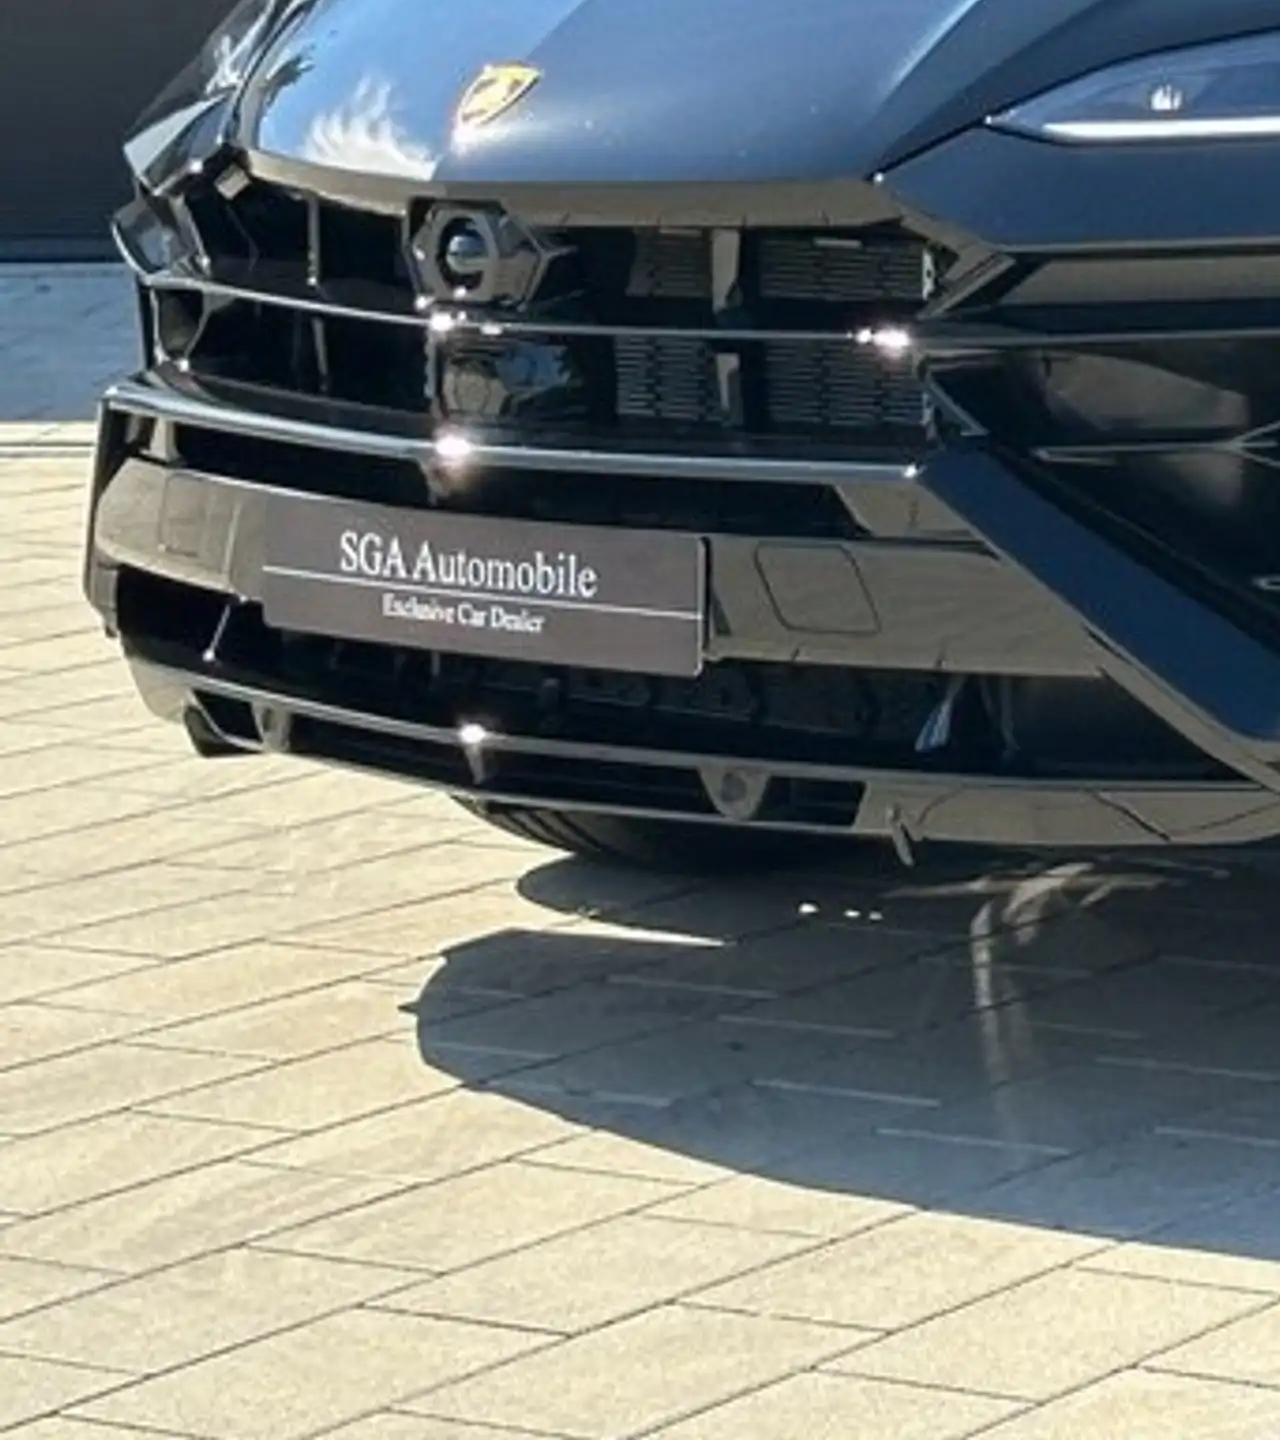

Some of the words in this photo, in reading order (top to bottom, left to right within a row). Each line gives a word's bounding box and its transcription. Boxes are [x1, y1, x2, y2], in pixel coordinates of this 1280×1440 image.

[340, 530, 406, 578] SGA
[412, 539, 597, 598] Automobile
[457, 602, 487, 628] Car
[490, 606, 545, 633] Dealer
